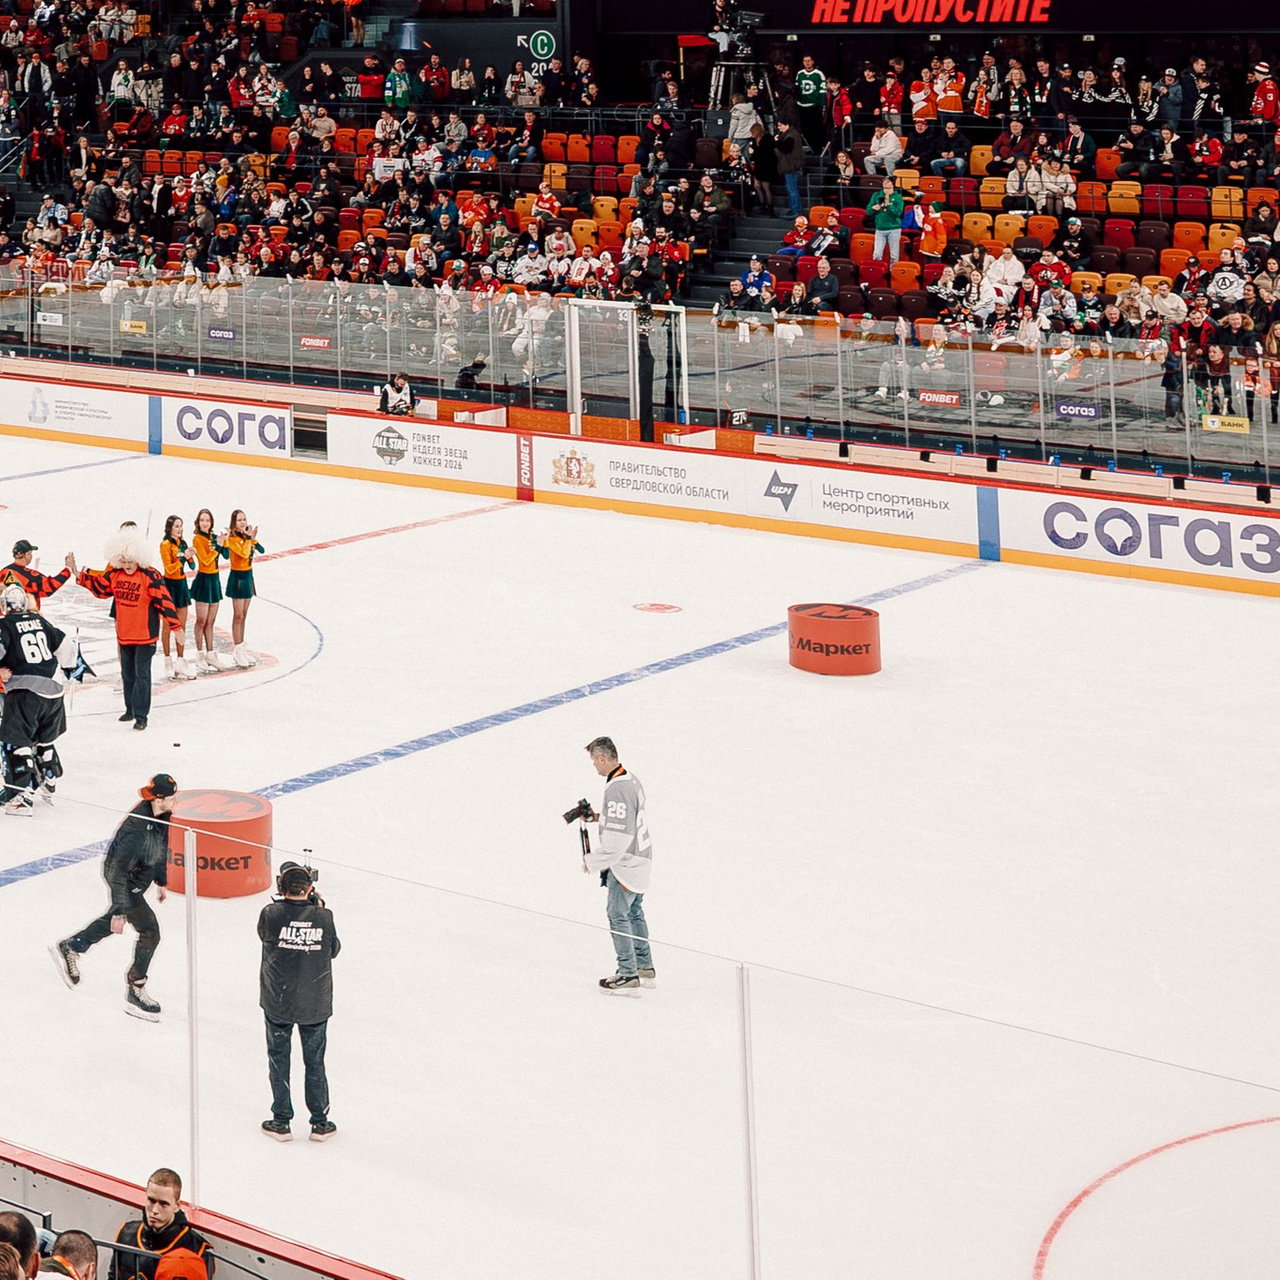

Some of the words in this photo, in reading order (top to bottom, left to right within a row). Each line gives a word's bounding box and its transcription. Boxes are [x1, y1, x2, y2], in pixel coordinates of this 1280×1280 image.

[300, 338, 329, 348] FONBET
[920, 392, 959, 404] FONBET
[1220, 420, 1246, 429] БАНК
[412, 433, 440, 444] FONBET
[412, 444, 442, 456] НЕДЕЛЯ
[444, 448, 468, 460] ЗВЕЗД
[521, 437, 531, 486] FONBET
[412, 456, 442, 467] ХОККЕЯ
[444, 459, 463, 470] 2026
[609, 460, 687, 480] ПРАВИТЕЛЬСТВО
[609, 477, 683, 497] СВЕРДЛОВСКОЙ
[685, 485, 729, 501] ОБЛАСТИ
[822, 483, 864, 502] Центр
[866, 490, 950, 513] спортивных
[822, 499, 915, 521] мероприятий
[20, 631, 53, 664] 60
[796, 637, 871, 656] Маркет
[607, 800, 627, 819] 26
